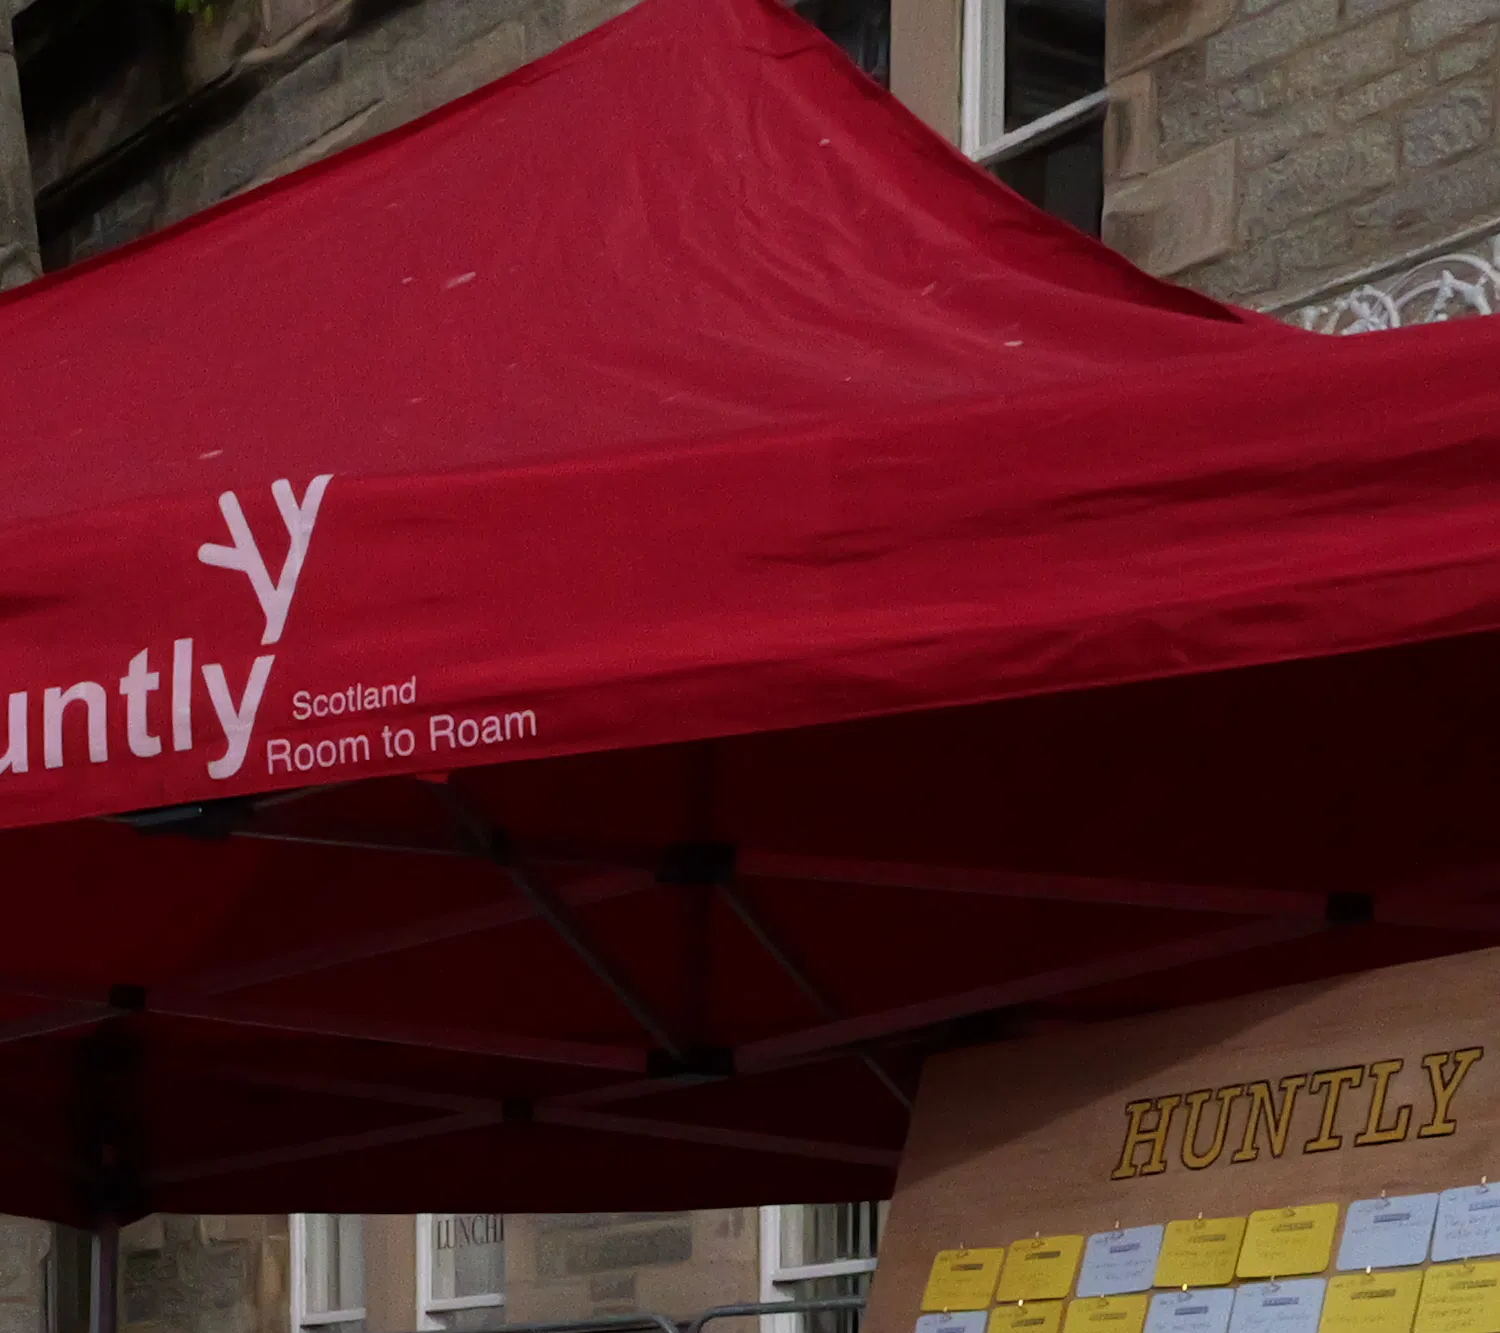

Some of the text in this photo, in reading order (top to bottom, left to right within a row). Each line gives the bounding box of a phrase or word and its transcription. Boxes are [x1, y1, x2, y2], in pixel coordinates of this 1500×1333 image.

[292, 676, 417, 722] Scotland
[267, 706, 537, 775] Room to Roam
[1110, 1046, 1484, 1181] HUNTLY
